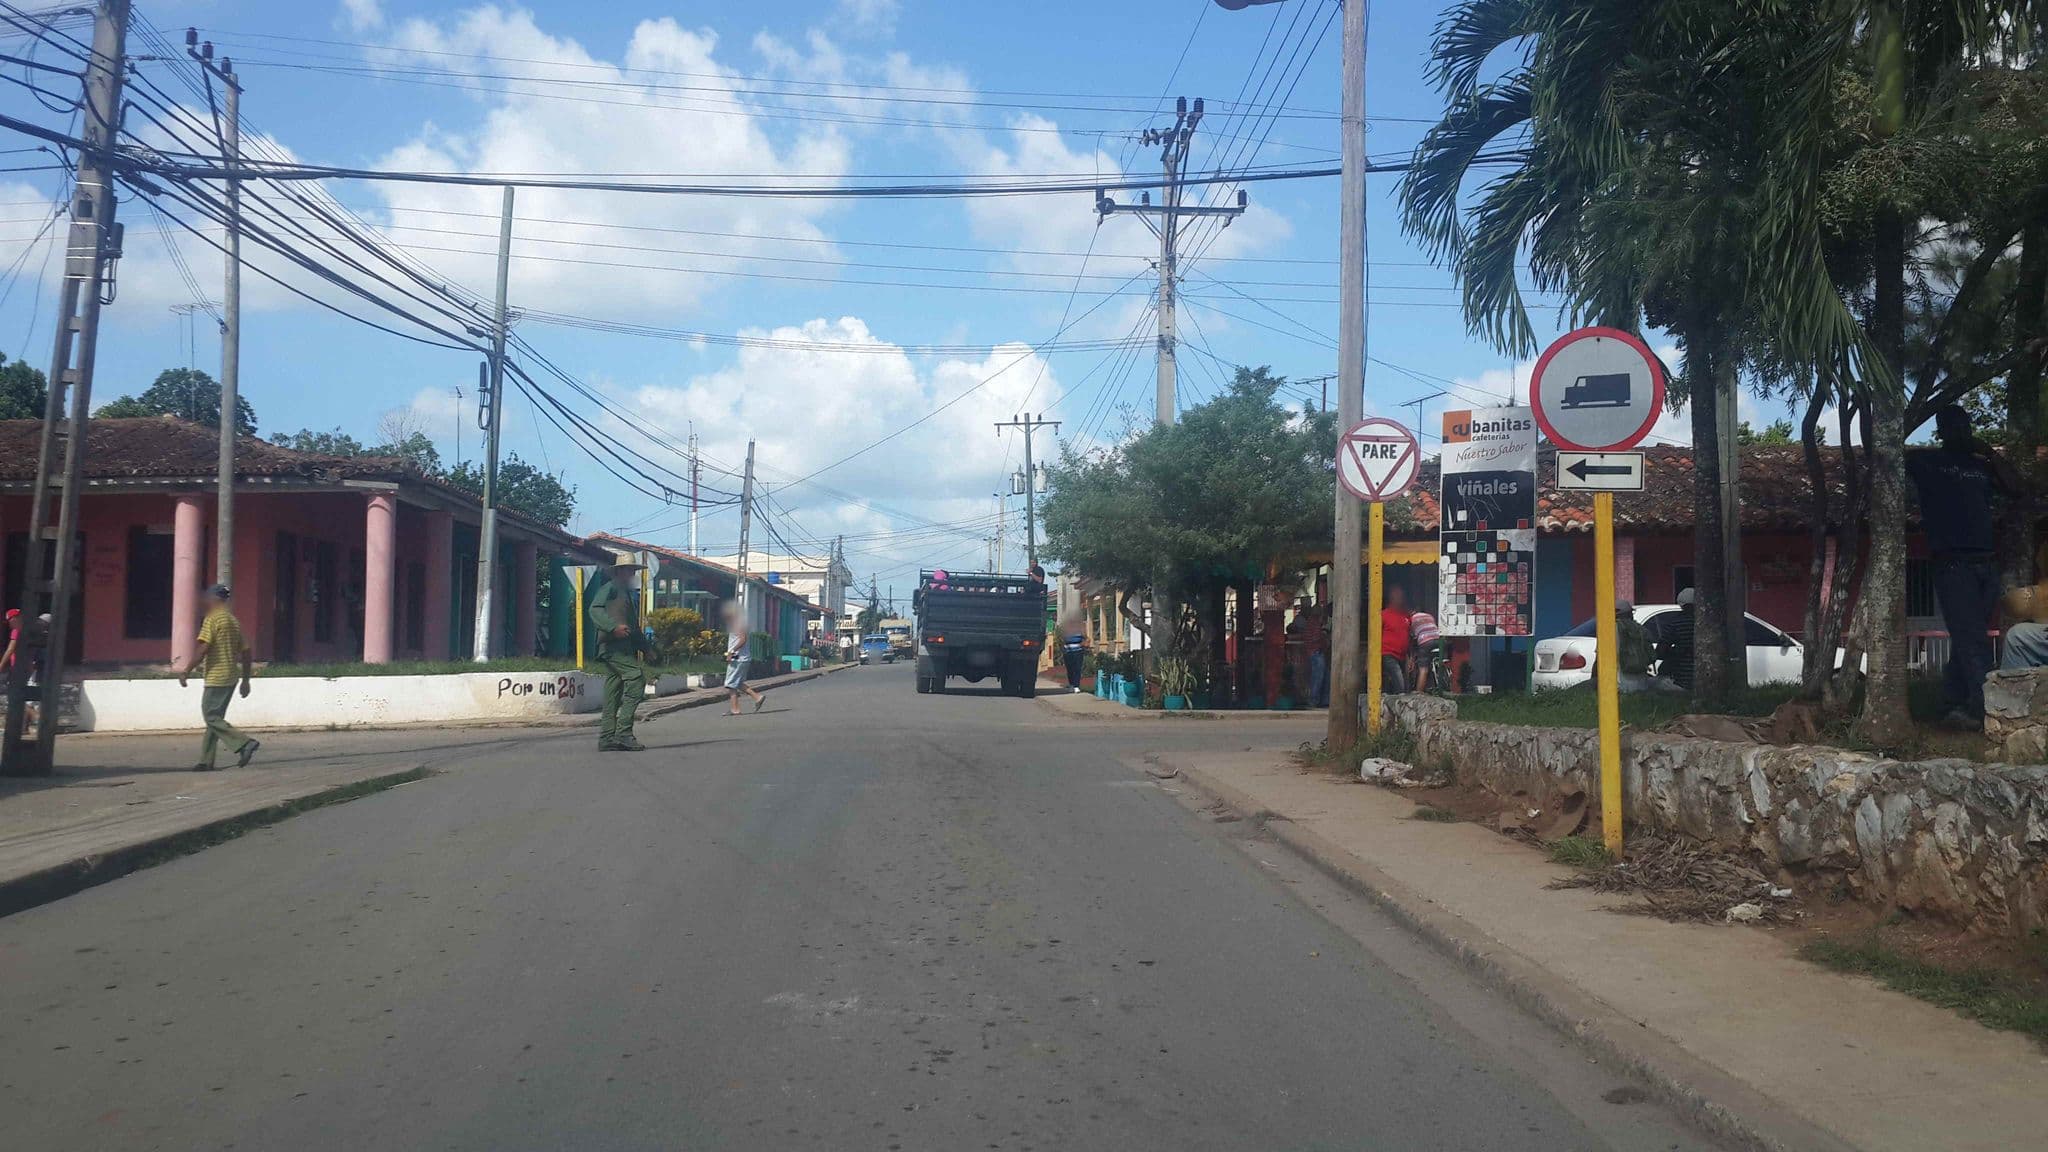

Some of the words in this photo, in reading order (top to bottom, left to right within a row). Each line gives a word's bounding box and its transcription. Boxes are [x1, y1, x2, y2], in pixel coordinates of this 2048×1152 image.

[1362, 444, 1398, 459] PARE
[1456, 447, 1496, 463] Nuestro
[1457, 479, 1518, 496] viñales
[498, 678, 534, 699] Por
[540, 681, 556, 696] un
[558, 676, 576, 699] 26
